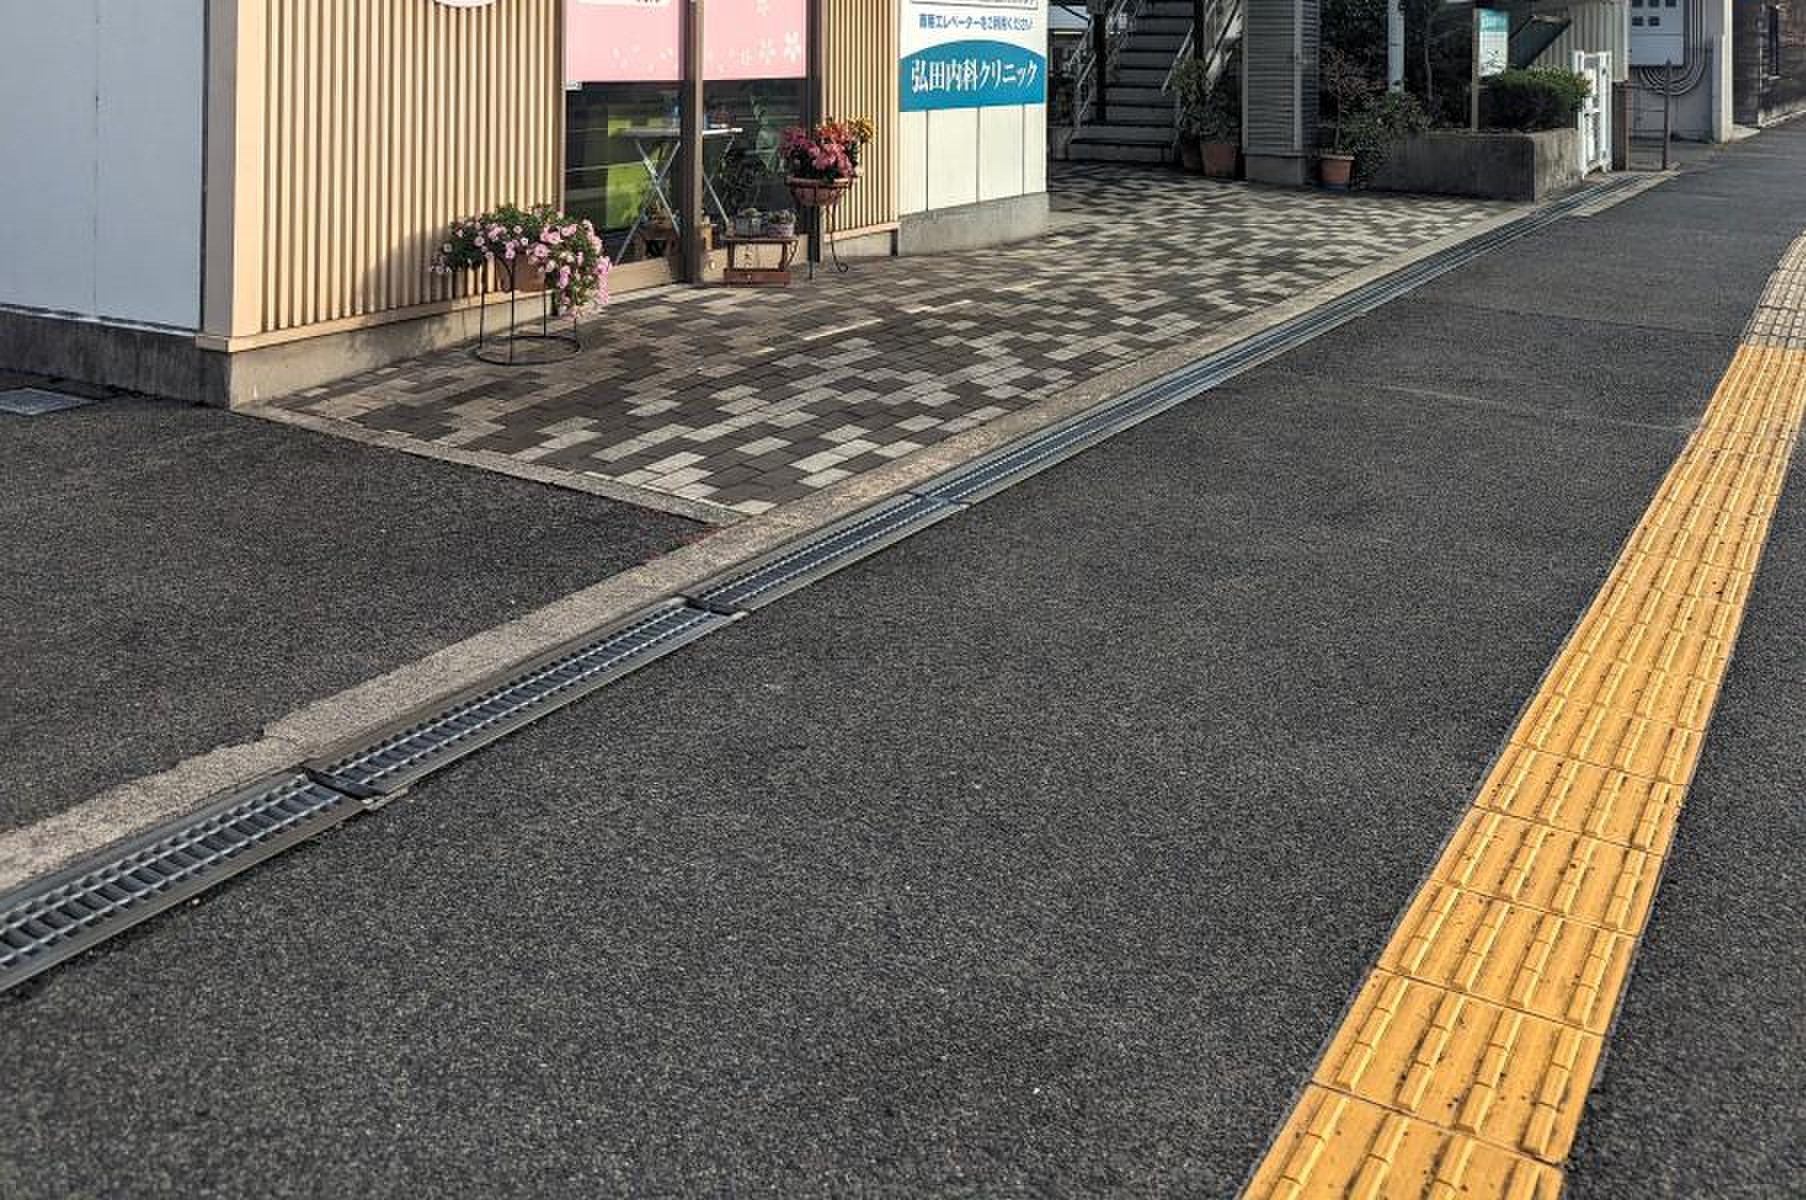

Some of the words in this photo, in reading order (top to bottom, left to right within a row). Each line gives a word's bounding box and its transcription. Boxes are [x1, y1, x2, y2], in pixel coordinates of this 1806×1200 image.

[911, 58, 1038, 94] 弘田内科クリニック
